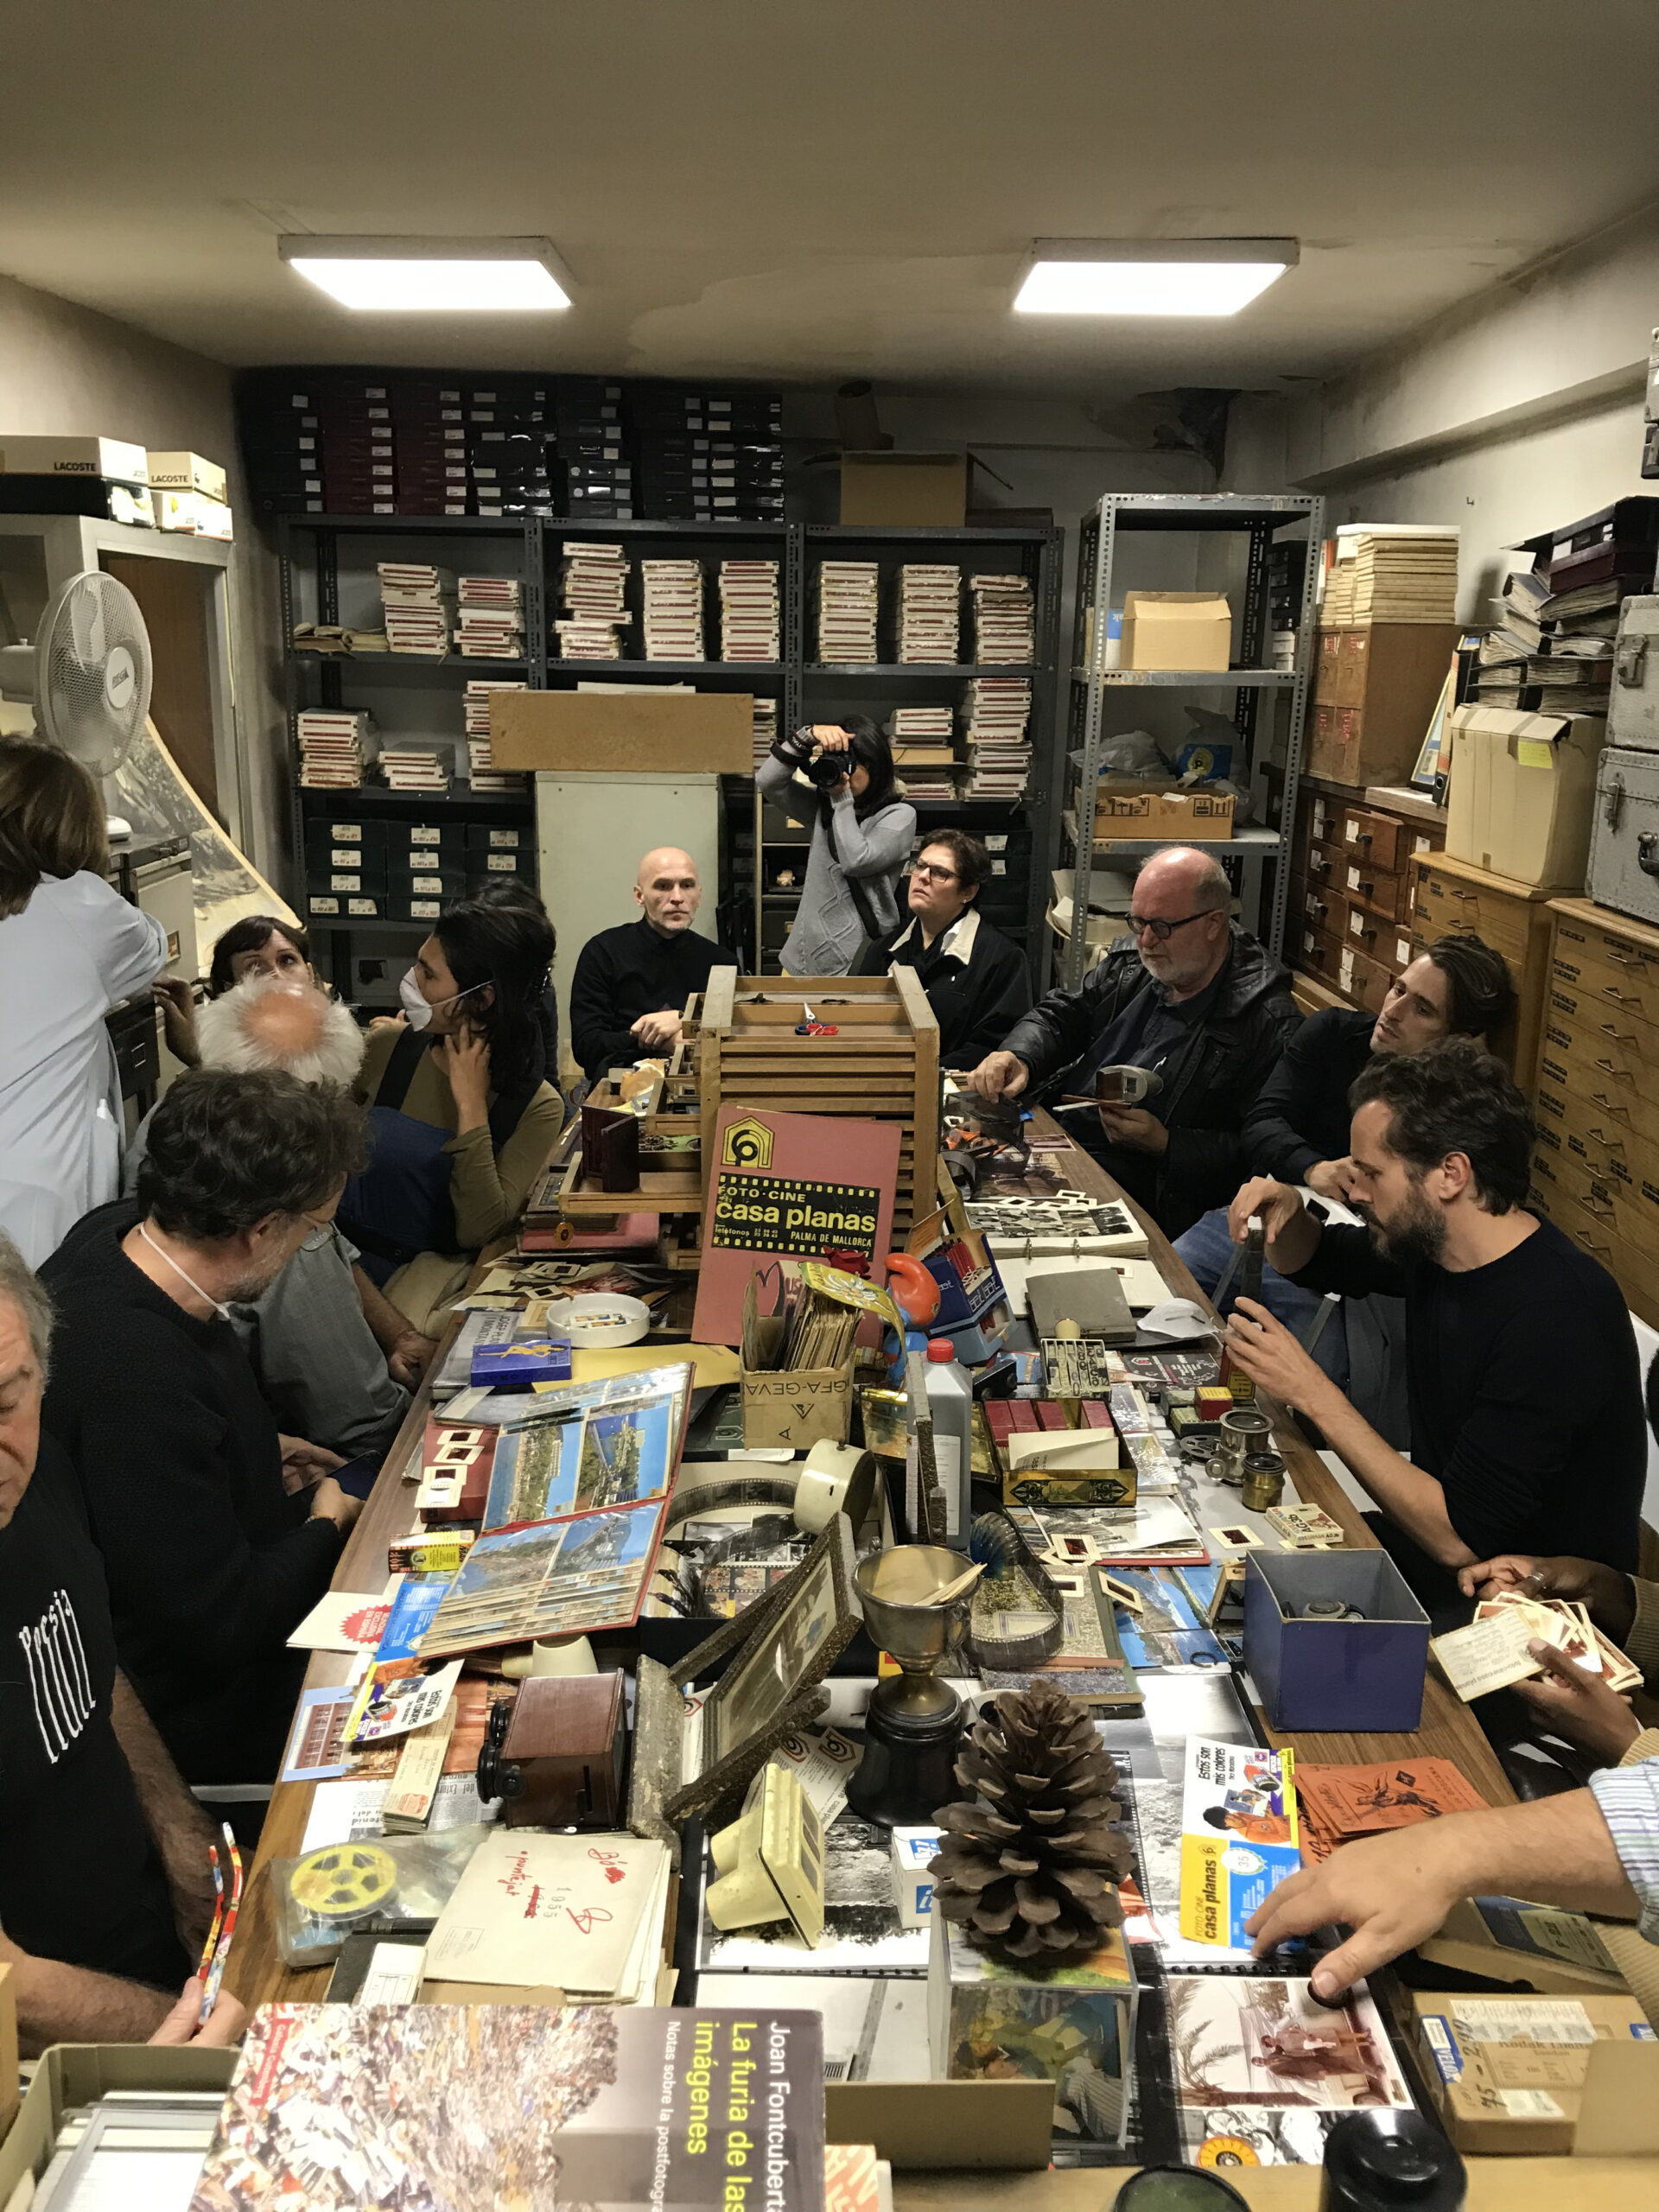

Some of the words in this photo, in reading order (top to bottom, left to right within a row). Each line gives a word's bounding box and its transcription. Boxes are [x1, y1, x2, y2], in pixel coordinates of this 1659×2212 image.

[54, 462, 96, 472] LACOSTE
[768, 1190, 806, 1203] CINE
[716, 1202, 779, 1224] casa
[785, 1205, 876, 1232] planas
[791, 1230, 817, 1242] PALMA
[819, 1234, 830, 1243] DE
[832, 1235, 872, 1248] MALLORCA
[745, 1382, 849, 1396] GFA-GEVA
[1201, 1746, 1211, 1759] son
[1214, 1747, 1225, 1771] colores
[1198, 1760, 1211, 1780] Estos
[1213, 1771, 1225, 1786] mis
[1238, 1855, 1249, 1867] 35
[1202, 1859, 1221, 1904] planas
[1205, 1906, 1217, 1939] casa
[664, 2021, 681, 2061] Notas
[733, 2021, 758, 2051] La
[770, 2021, 791, 2074] Joan
[661, 2064, 676, 2104] sobre
[685, 2021, 721, 2154] imágenes
[728, 2060, 757, 2121] furia
[659, 2109, 674, 2121] la
[727, 2131, 753, 2166] de
[724, 2176, 753, 2212] las
